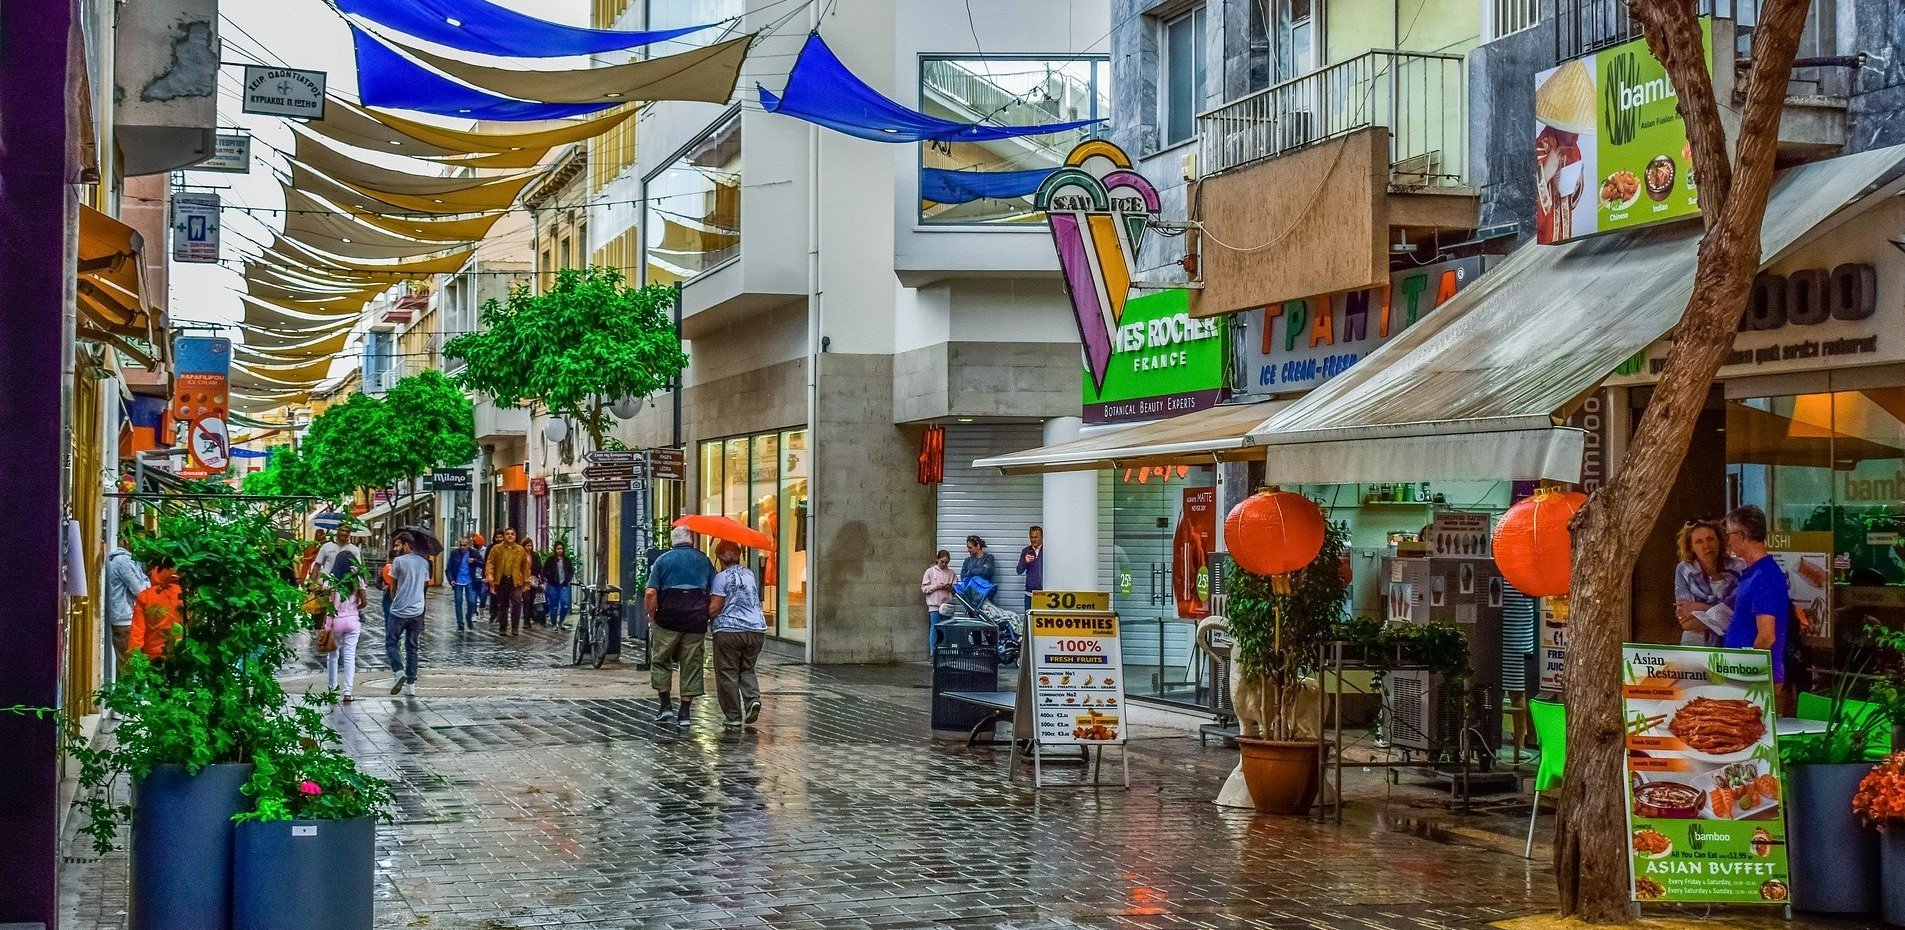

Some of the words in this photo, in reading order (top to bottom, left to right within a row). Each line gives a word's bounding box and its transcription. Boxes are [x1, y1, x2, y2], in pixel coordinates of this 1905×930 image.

[267, 69, 322, 99] ΟΔΟΝΤΙΑΤΡΟΣ
[1620, 73, 1676, 111] bamb
[250, 94, 286, 106] ΚΥΡΙΑΚΟΣ
[1640, 118, 1656, 130] Asian
[1656, 114, 1675, 126] Fusion
[1110, 196, 1142, 211] ICE
[1652, 203, 1669, 212] Indian
[1115, 321, 1145, 353] VES
[1147, 312, 1219, 348] ROCHER
[1133, 351, 1187, 372] FRANCE
[1259, 363, 1277, 387] ICE
[1140, 400, 1164, 414] BEAUTY
[1167, 396, 1196, 411] EXPERTS
[1583, 397, 1601, 493] amboo
[434, 473, 466, 483] Milano
[1844, 470, 1905, 501] bamb
[1197, 492, 1212, 503] MATTE
[1046, 592, 1076, 609] 30
[1035, 617, 1113, 630] SMOOTHIES
[1057, 640, 1102, 652] 100%
[1546, 661, 1565, 671] JUIC
[1632, 652, 1665, 666] Asian
[1646, 665, 1708, 681] Restaurant
[1715, 662, 1759, 676] bamboo
[1694, 831, 1731, 842] bamboo
[1670, 850, 1680, 858] All
[1693, 851, 1706, 859] Can
[1706, 851, 1719, 859] Eat
[1645, 861, 1702, 874] ASIAN
[1708, 861, 1776, 875] BUFFET
[1668, 878, 1684, 886] Every
[1684, 878, 1702, 886] Friday
[1667, 887, 1683, 895] Every
[1683, 887, 1708, 895] Saturday
